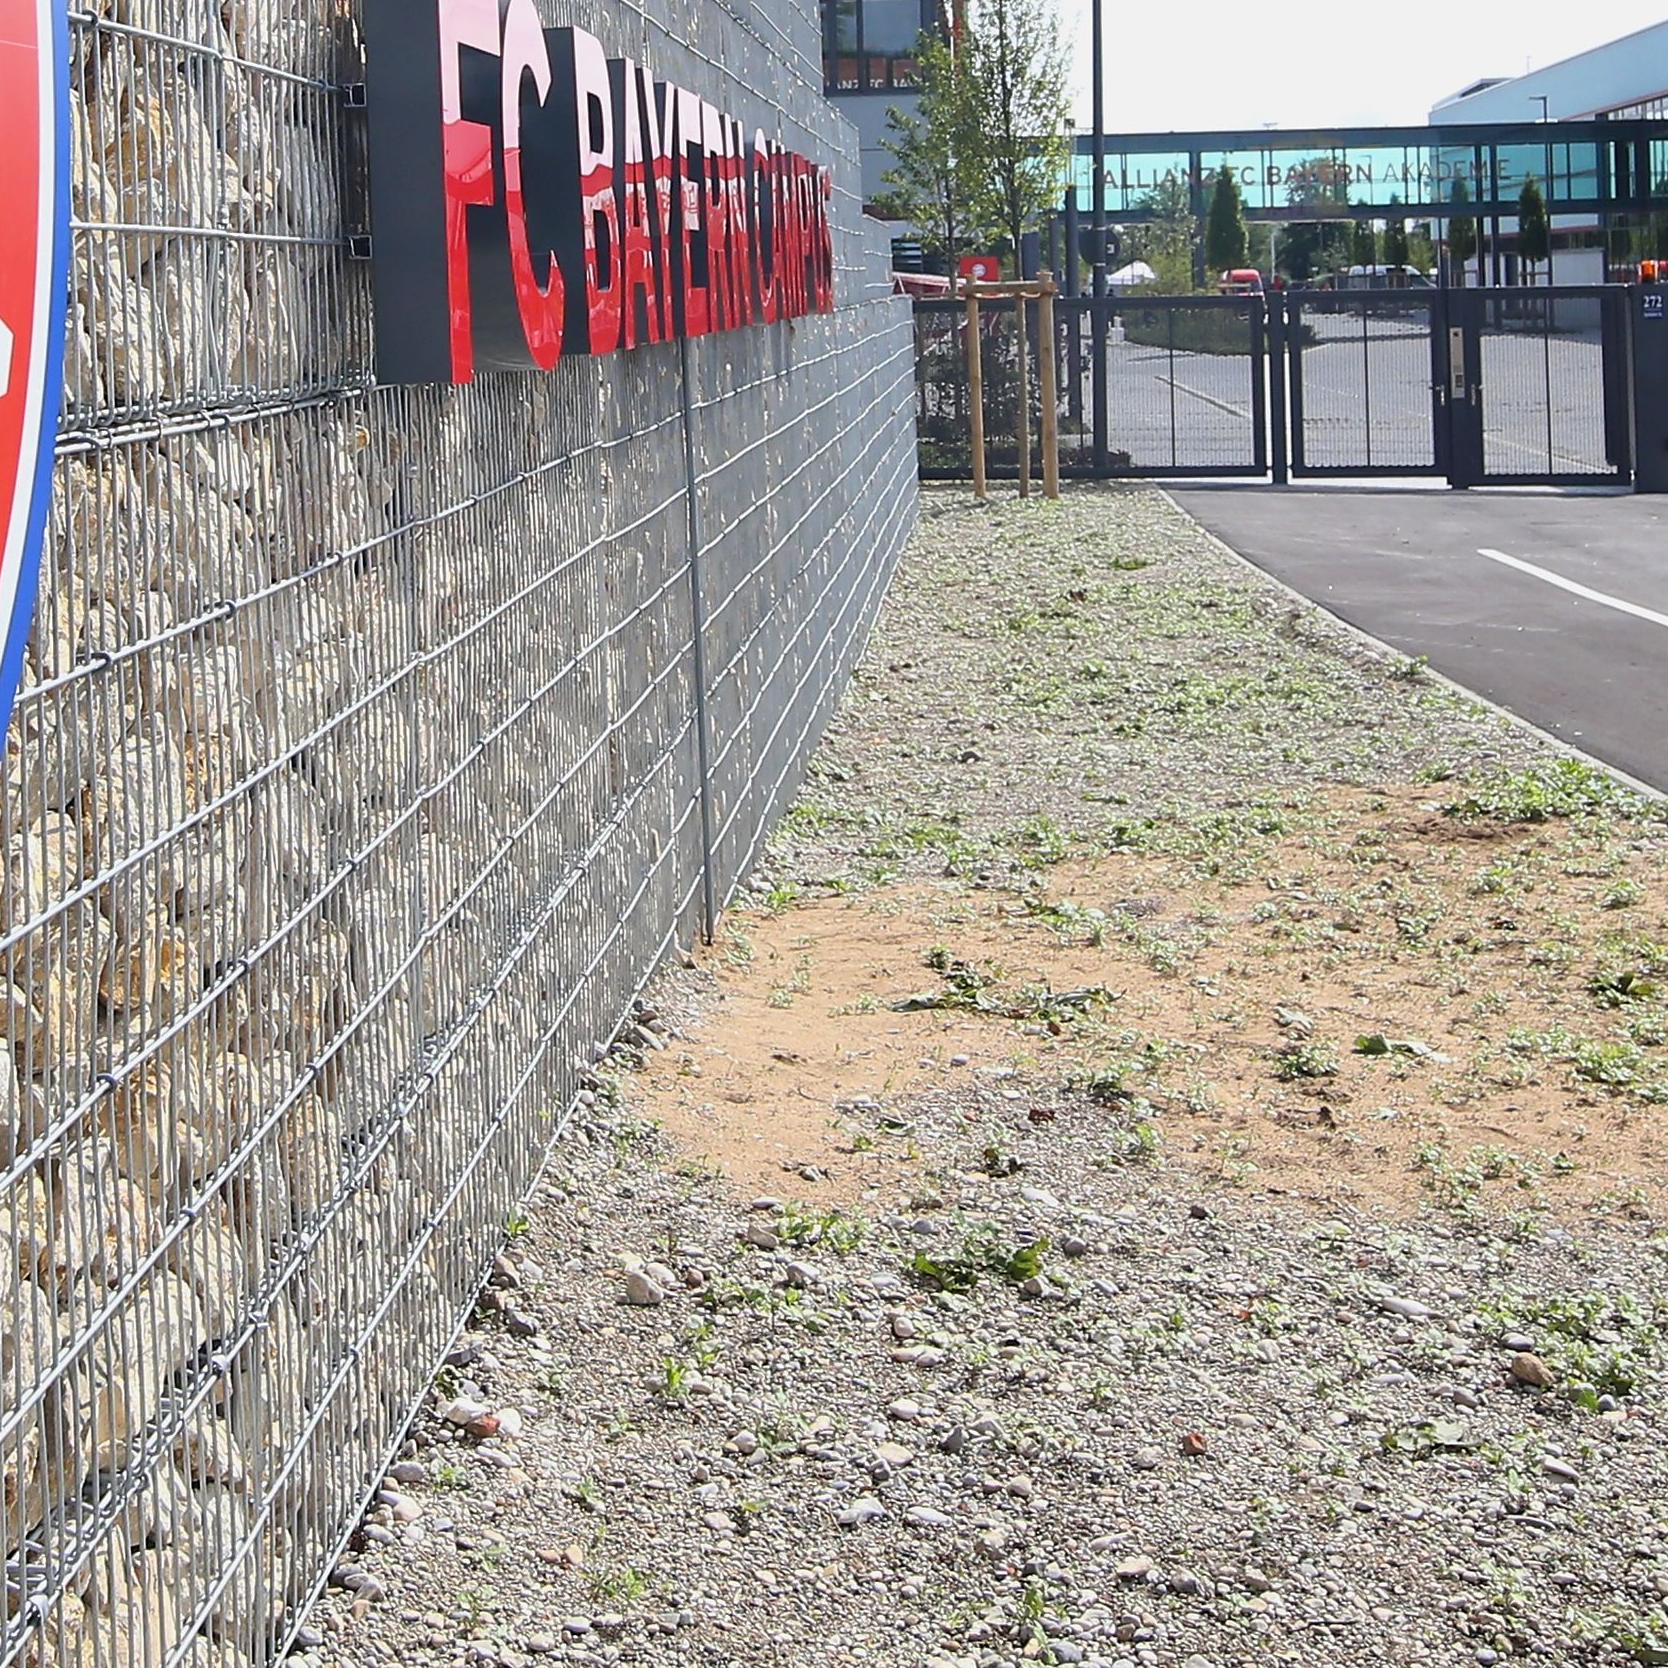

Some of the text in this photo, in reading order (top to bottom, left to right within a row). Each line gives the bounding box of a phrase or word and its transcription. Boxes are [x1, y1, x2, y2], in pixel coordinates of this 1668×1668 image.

[1382, 158, 1512, 183] AKADEME
[573, 25, 753, 357] BAYERN
[754, 128, 834, 325] CAMPUS
[1643, 295, 1663, 308] 272
